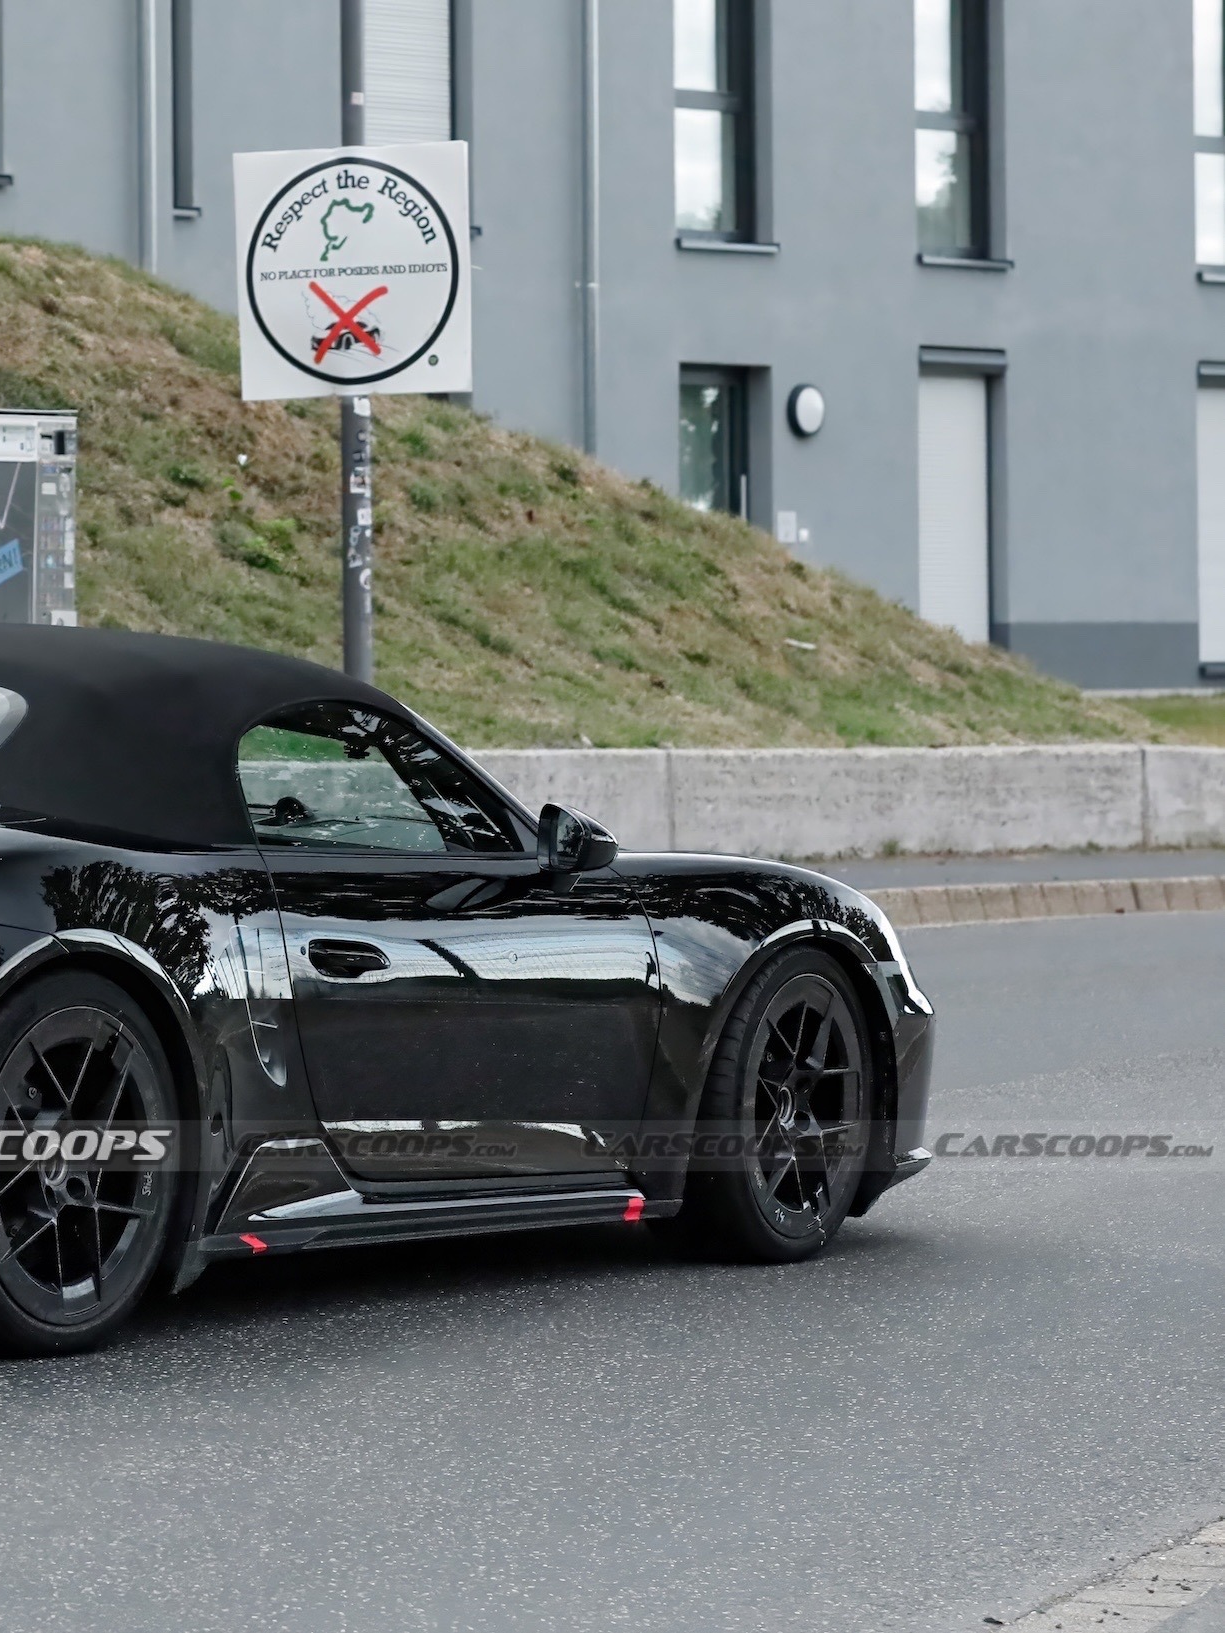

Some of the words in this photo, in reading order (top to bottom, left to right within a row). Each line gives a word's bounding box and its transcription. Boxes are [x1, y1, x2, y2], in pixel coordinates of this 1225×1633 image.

[261, 178, 329, 252] Respect
[336, 169, 370, 190] the
[378, 176, 437, 245] Region
[260, 271, 276, 282] NO
[278, 269, 312, 281] PLACE
[313, 268, 336, 279] FOR
[337, 265, 380, 278] POSERS
[381, 264, 407, 275] AND
[408, 262, 448, 274] IDIOTS
